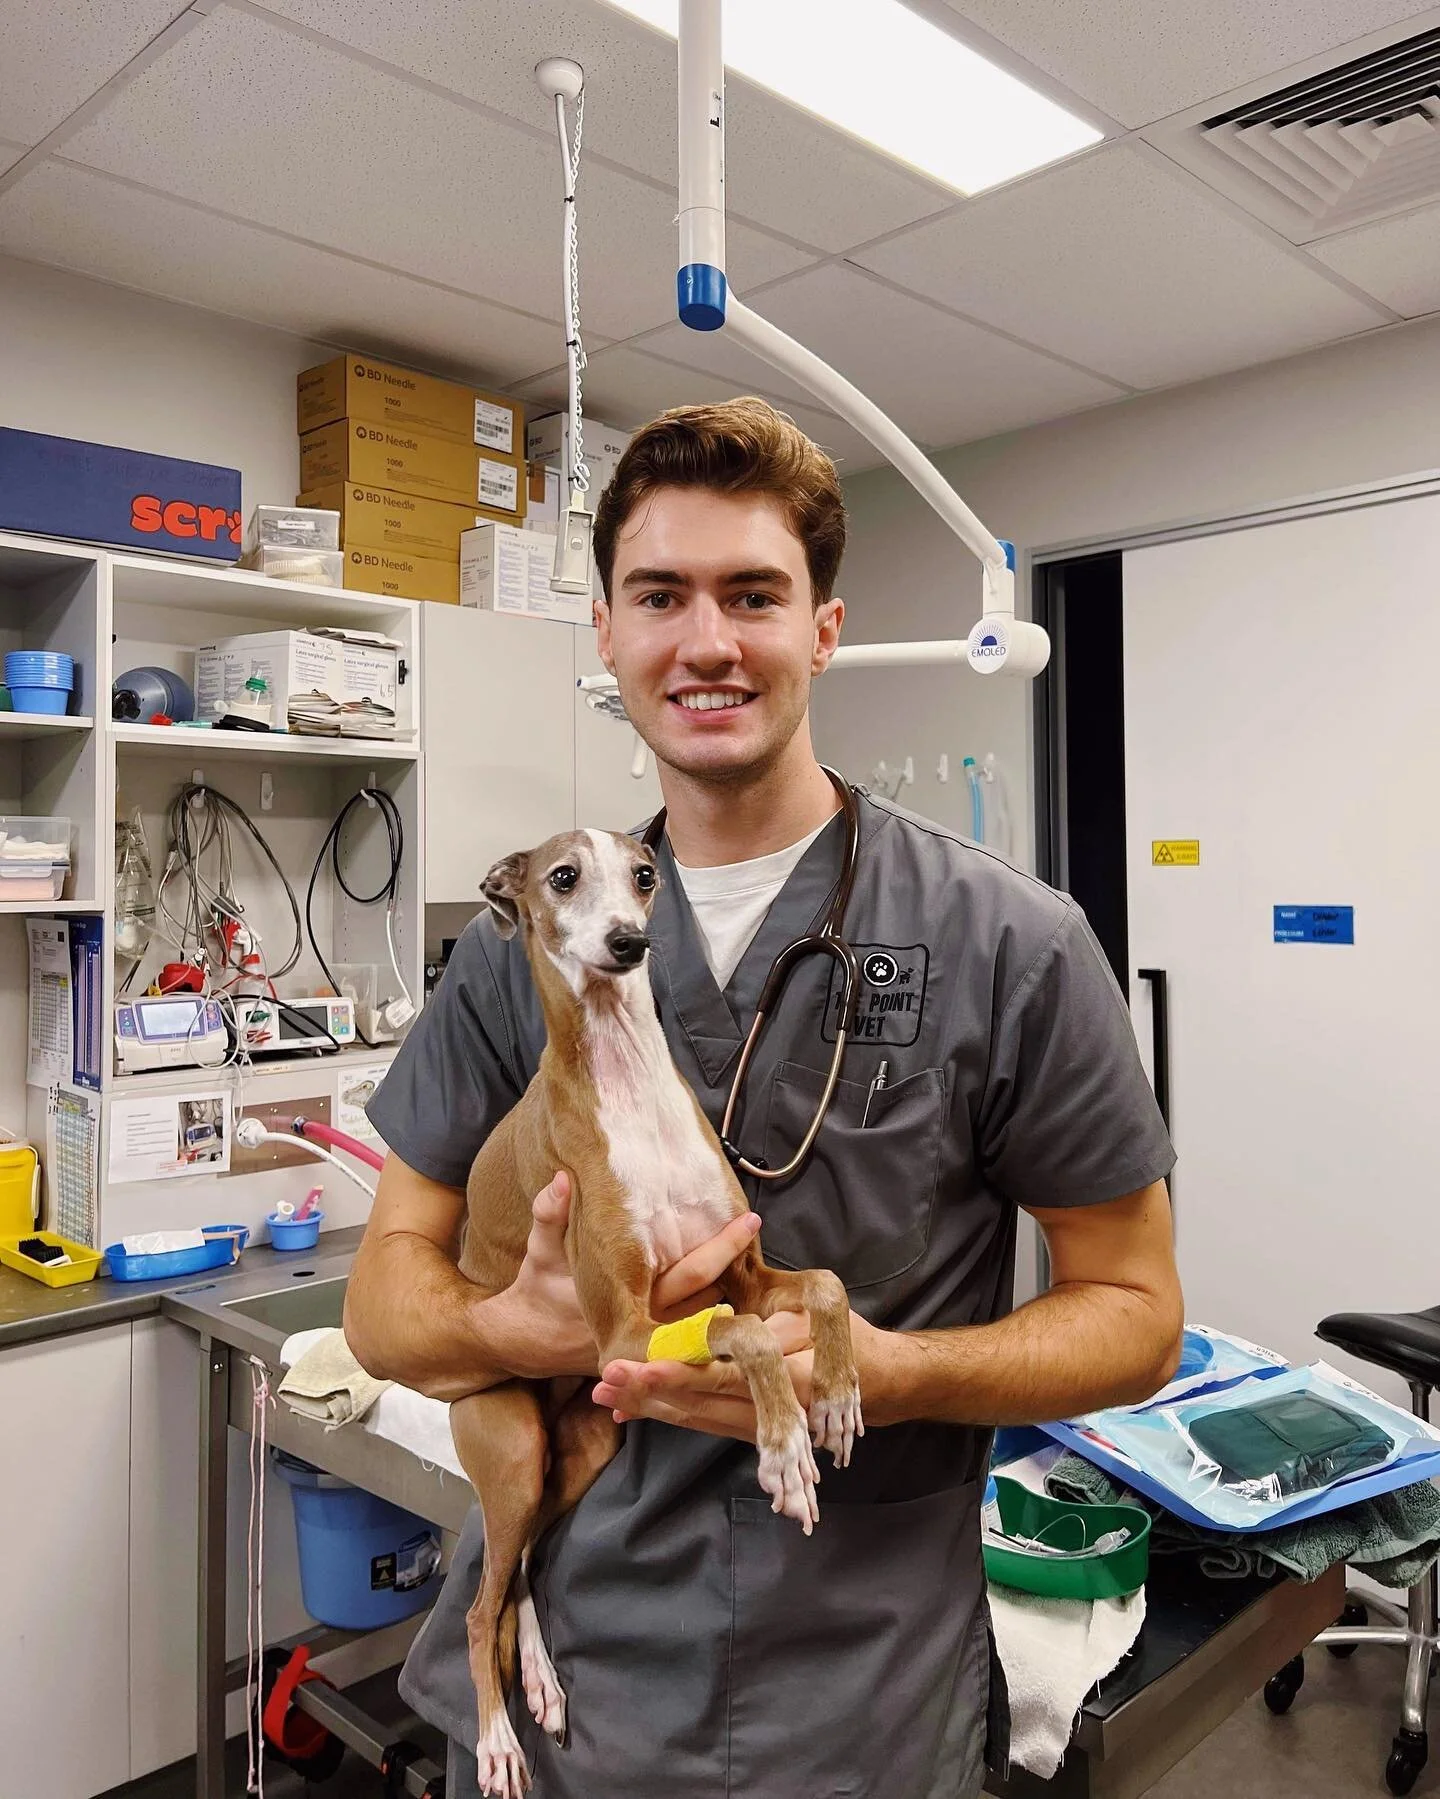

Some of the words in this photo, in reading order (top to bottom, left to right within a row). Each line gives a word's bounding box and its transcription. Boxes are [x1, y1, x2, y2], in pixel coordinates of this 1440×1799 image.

[367, 369, 382, 381] BD
[384, 373, 417, 391] Needle
[385, 396, 402, 407] 1000
[368, 430, 384, 442] BD
[386, 434, 418, 451] Needle
[387, 457, 404, 468] 1000
[366, 492, 381, 504] BD
[383, 495, 416, 511] Needle
[385, 519, 401, 529] 1000
[364, 554, 379, 566] BD
[381, 558, 414, 573] Needle
[382, 581, 399, 591] 1000
[971, 646, 1007, 657] EMOLED
[869, 991, 915, 1013] POINT
[854, 1015, 886, 1038] VET
